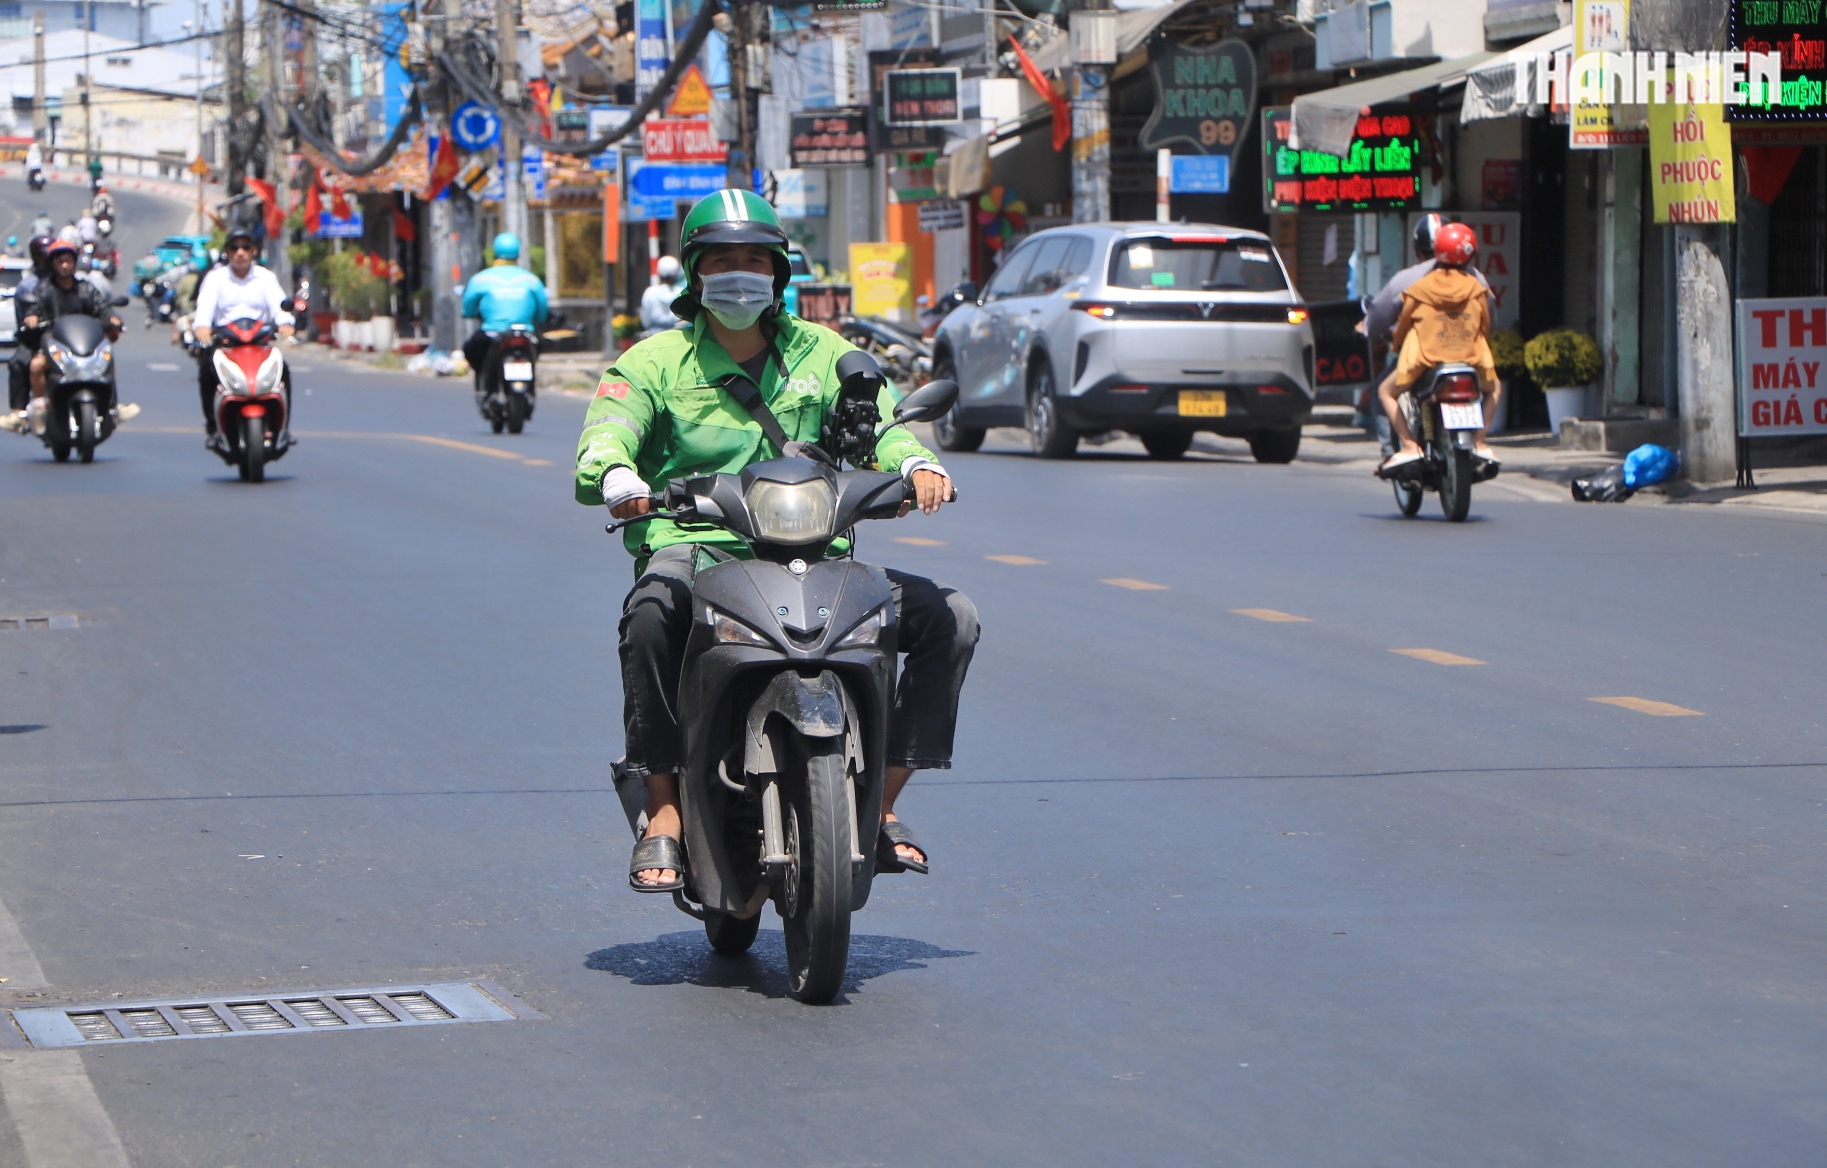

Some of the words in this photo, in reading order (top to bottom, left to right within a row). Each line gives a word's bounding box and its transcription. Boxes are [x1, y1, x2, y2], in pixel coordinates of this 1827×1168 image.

[1174, 55, 1237, 85] NHA
[1164, 88, 1247, 118] KHOA
[1199, 119, 1237, 146] 99
[1673, 110, 1705, 143] HỒI
[1661, 154, 1722, 186] PHUỘC
[1668, 194, 1720, 222] NHÚN
[1752, 308, 1827, 348] TH
[1315, 354, 1366, 382] CAO
[1752, 356, 1820, 390] MÁY
[1752, 393, 1804, 427] GIÁ
